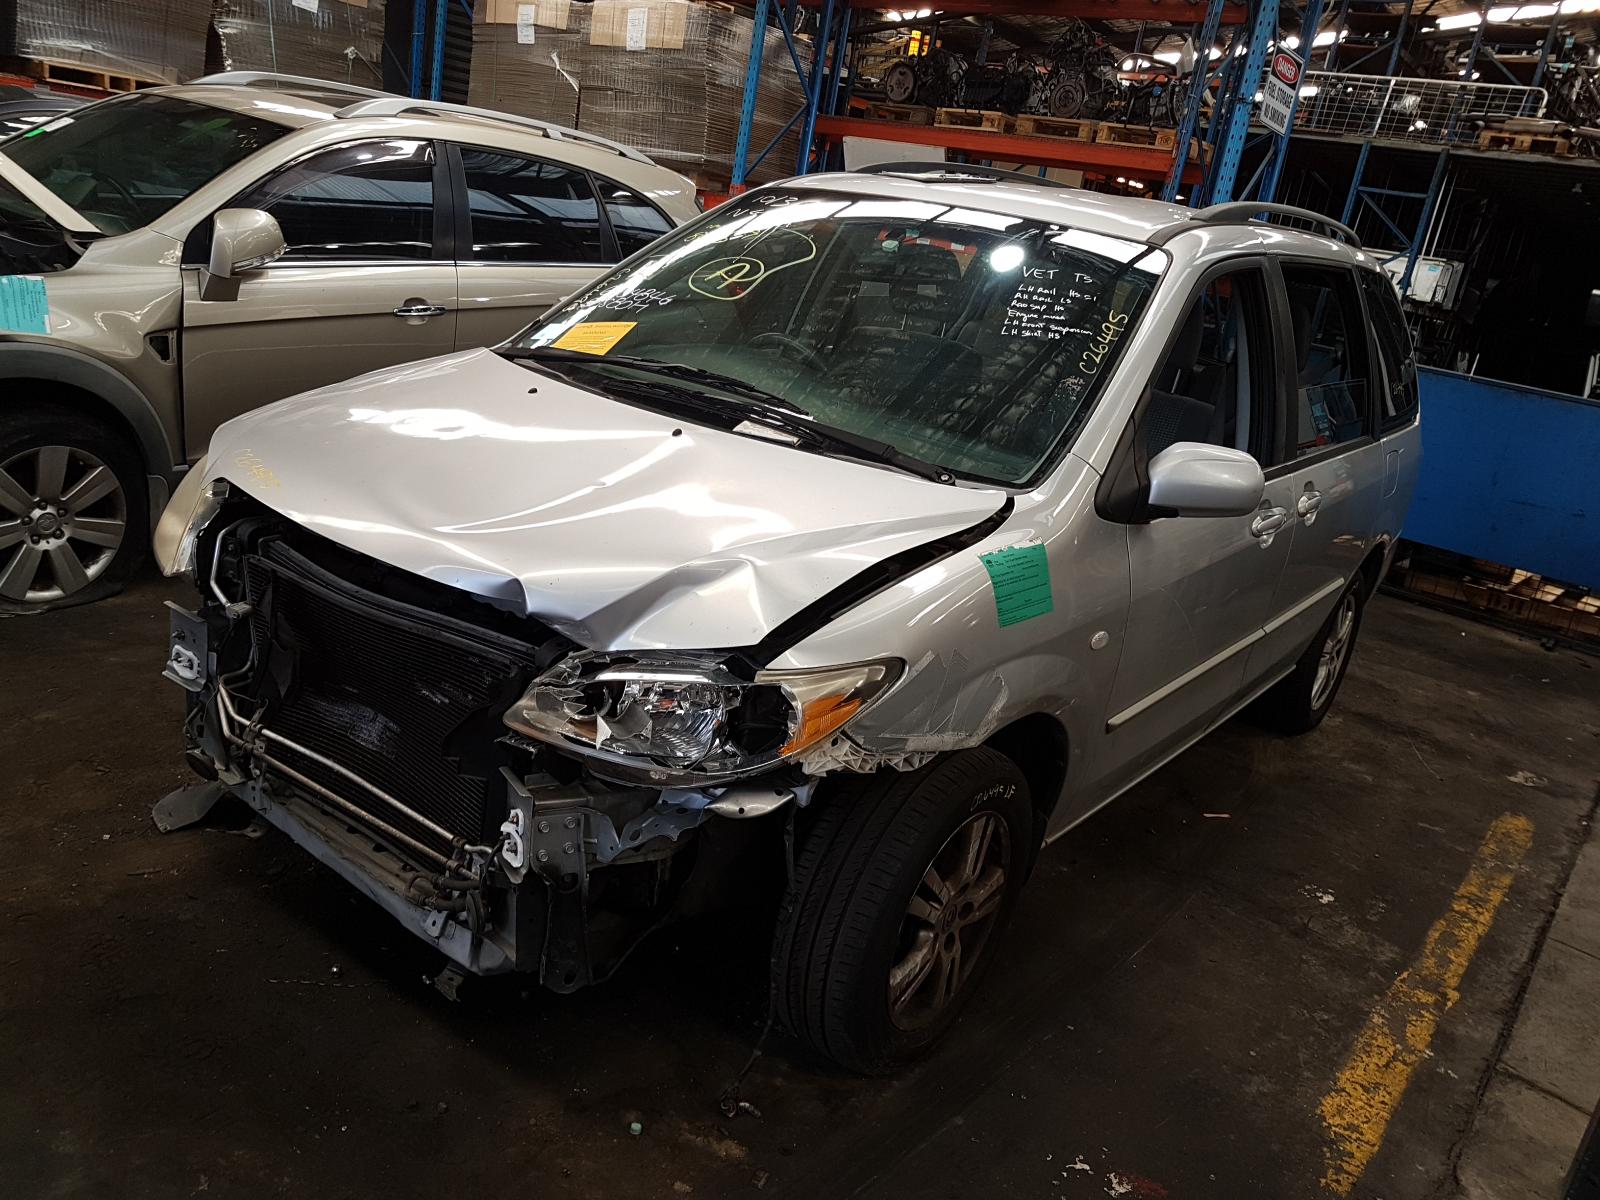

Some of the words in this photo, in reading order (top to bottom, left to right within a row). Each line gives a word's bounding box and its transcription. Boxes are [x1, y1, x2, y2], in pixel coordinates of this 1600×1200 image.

[1277, 57, 1296, 80] DANGER
[1268, 80, 1277, 99] FUEL
[1276, 86, 1294, 109] STORAGE
[1264, 102, 1271, 119] NO
[1269, 106, 1287, 127] SMOKING
[1023, 266, 1060, 280] VET
[1074, 272, 1093, 284] TS
